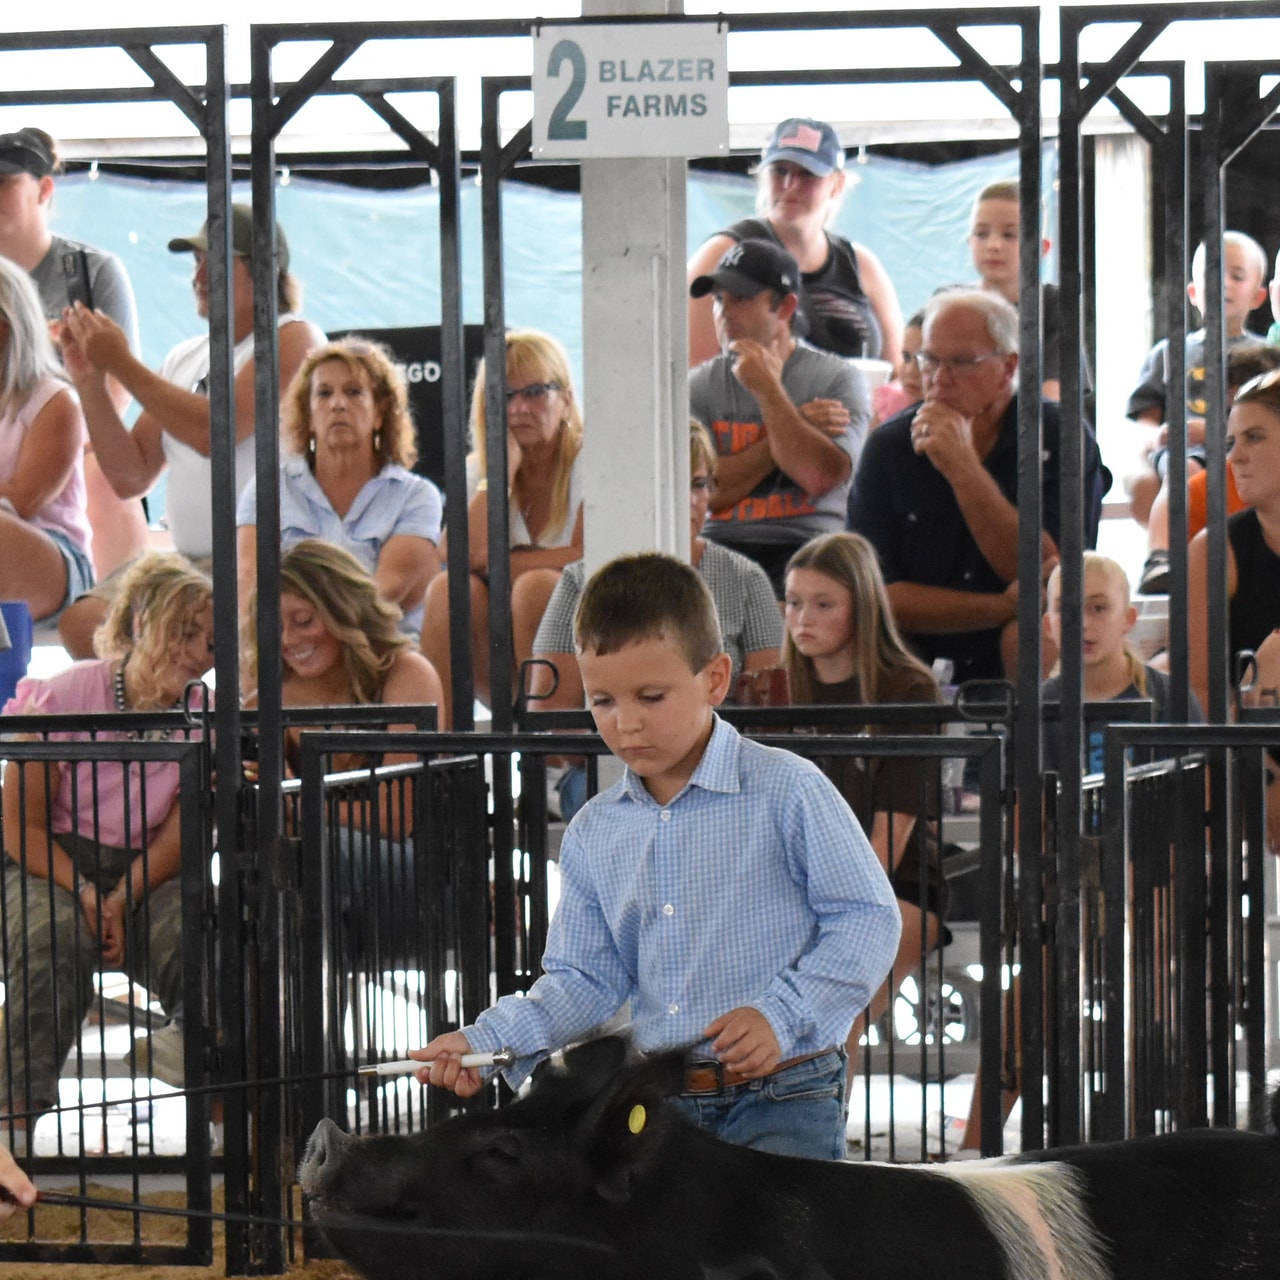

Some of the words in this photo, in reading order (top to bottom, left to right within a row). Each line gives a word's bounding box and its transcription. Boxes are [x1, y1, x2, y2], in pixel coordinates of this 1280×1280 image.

[598, 58, 715, 83] BLAZER
[547, 40, 587, 141] 2
[606, 93, 708, 118] FARMS
[711, 419, 767, 453] TIG
